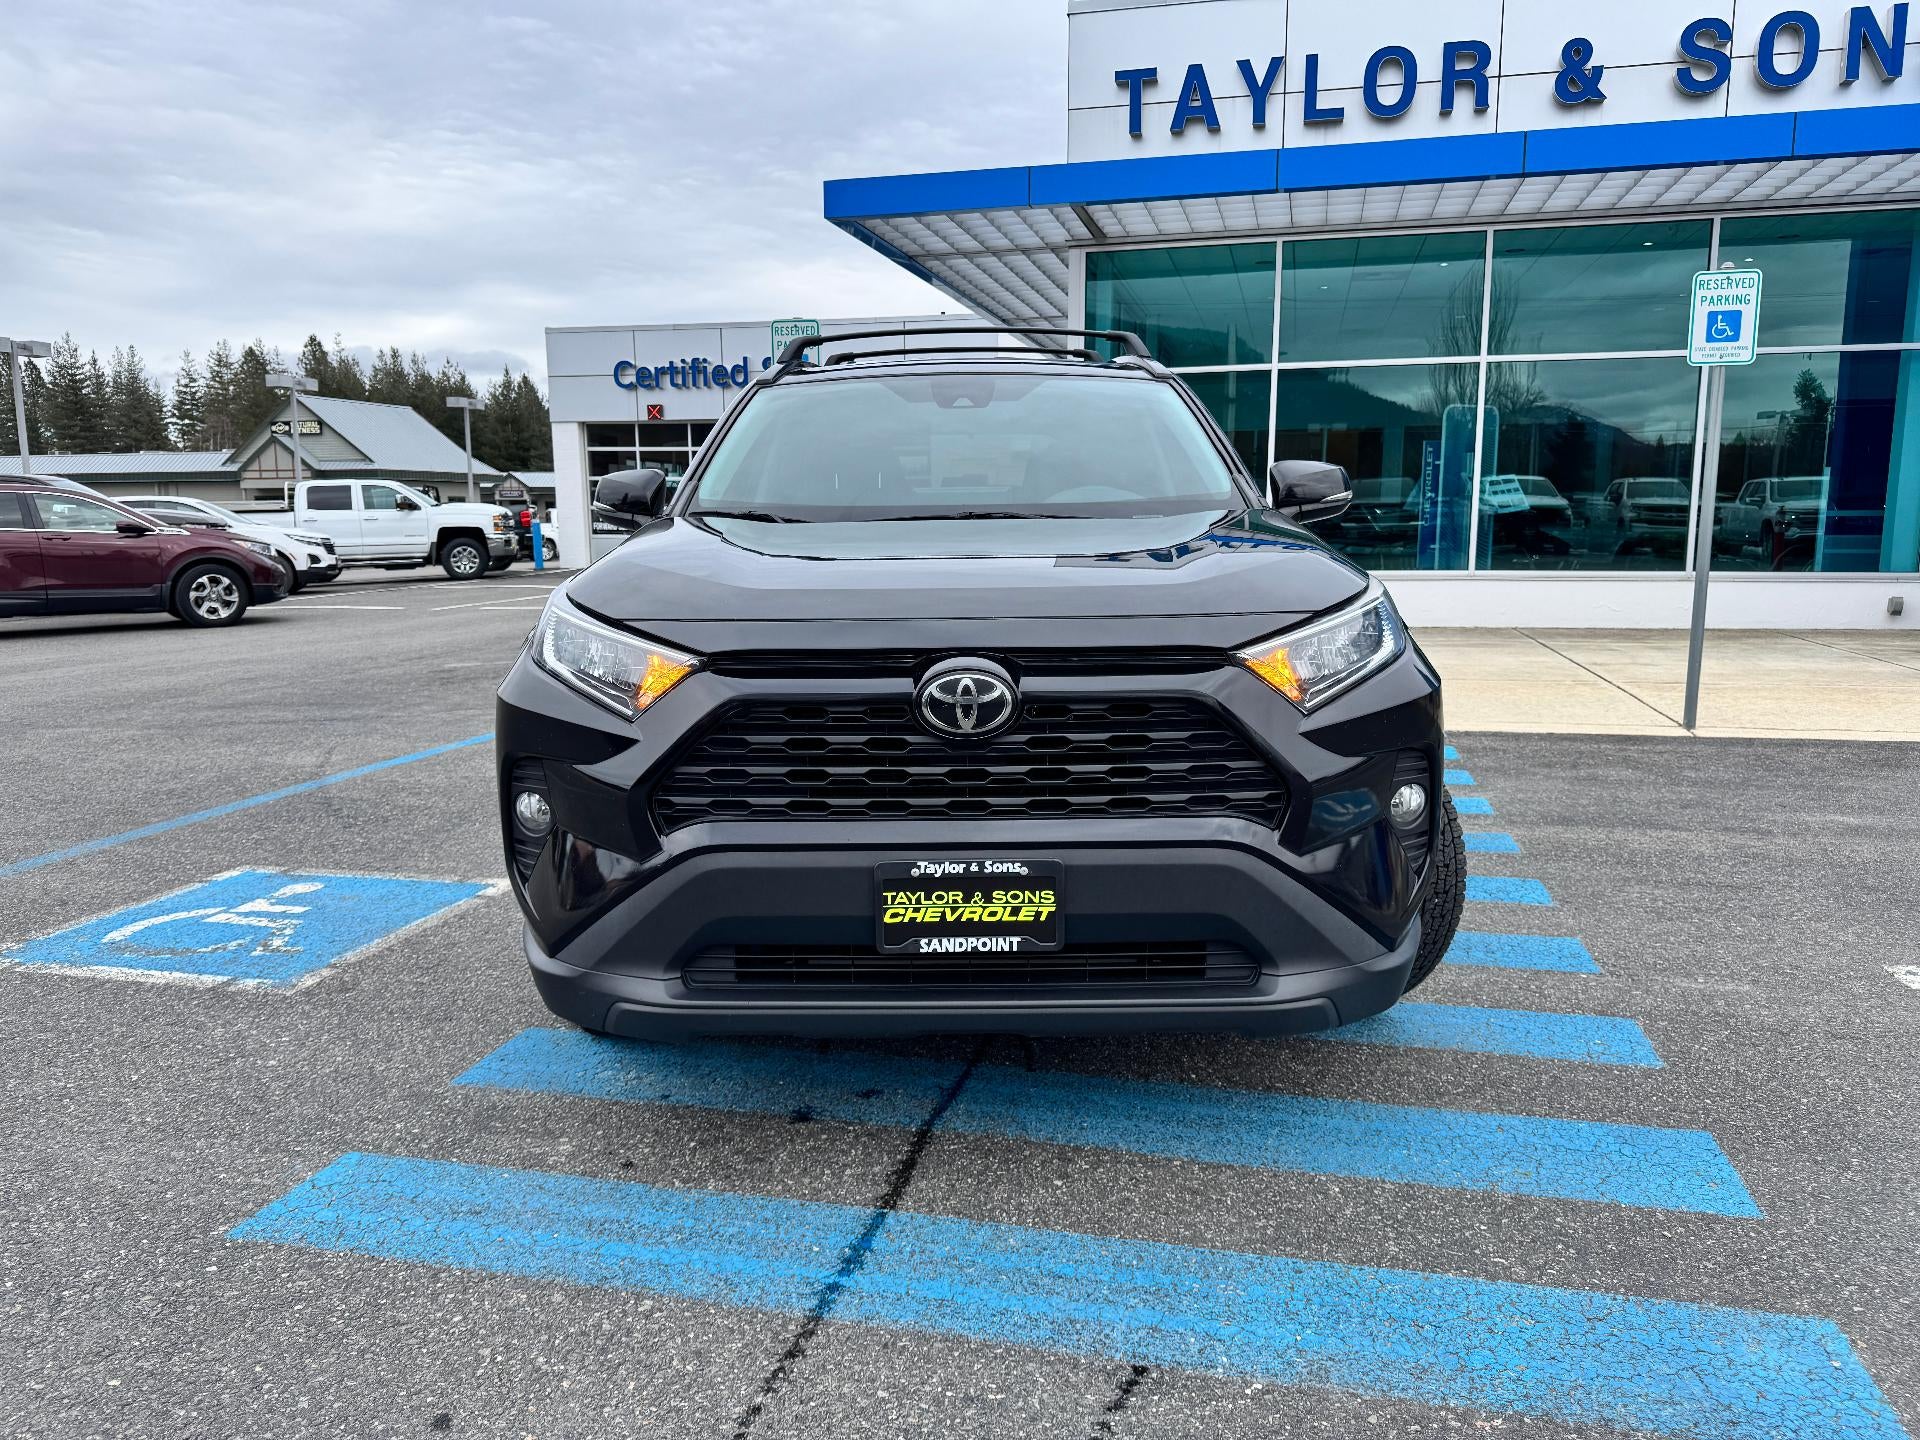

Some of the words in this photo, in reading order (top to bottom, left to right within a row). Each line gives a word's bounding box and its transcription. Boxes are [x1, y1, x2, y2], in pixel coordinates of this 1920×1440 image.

[1114, 40, 1491, 137] TAYLOR
[1553, 37, 1607, 106] &
[1673, 2, 1909, 97] SON
[1698, 277, 1755, 291] RESERVED
[1700, 293, 1751, 307] PARKING
[774, 325, 816, 336] RESERVED
[613, 356, 749, 390] Certified
[917, 861, 966, 877] Taylor
[970, 863, 980, 872] &
[984, 861, 1021, 873] Sons
[883, 891, 963, 904] TAYLOR
[971, 891, 984, 906] &
[992, 890, 1055, 904] SONS
[883, 906, 1056, 923] CHEVROLET
[919, 936, 1021, 953] SANDPOINT
